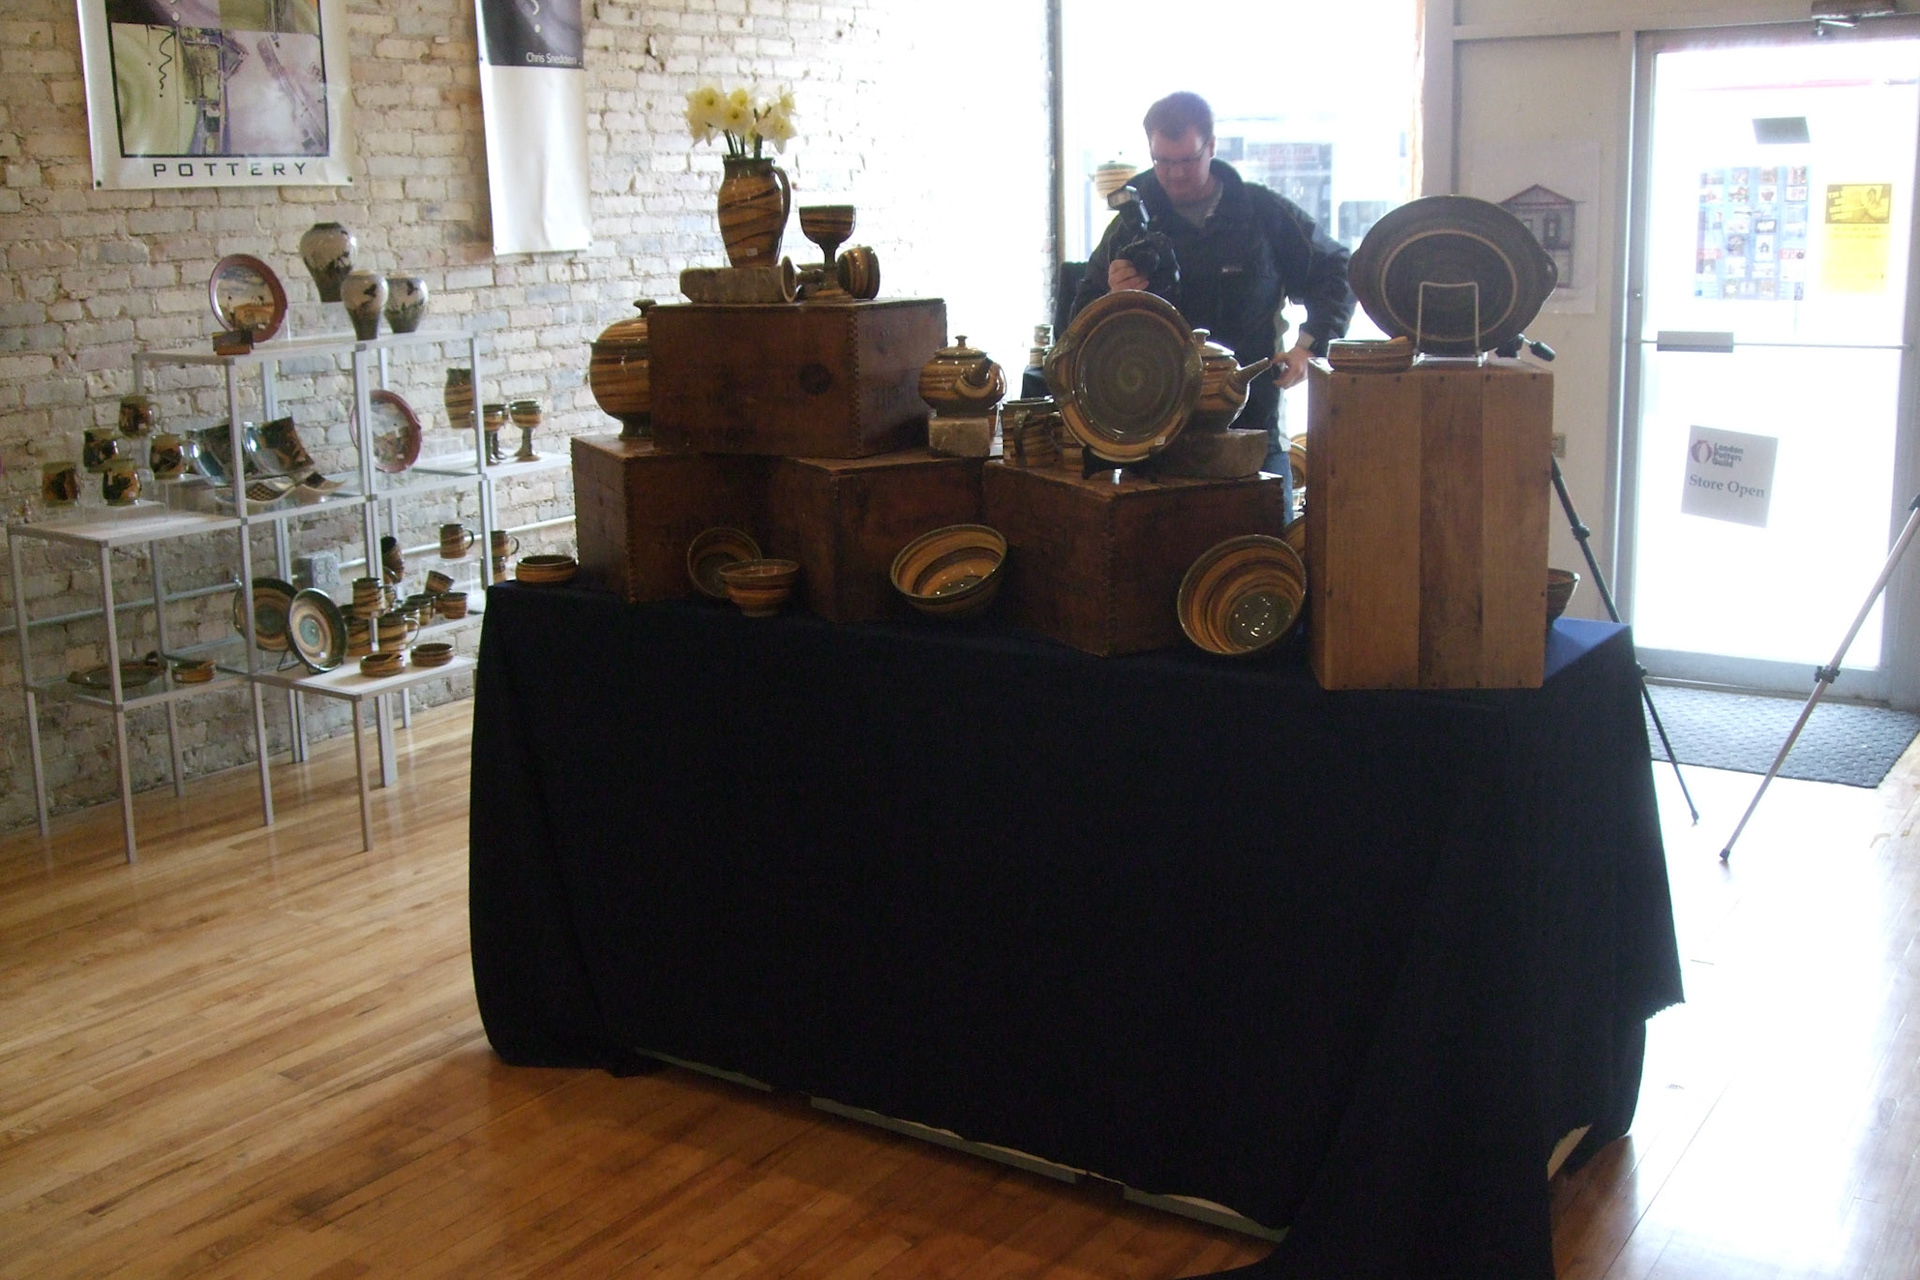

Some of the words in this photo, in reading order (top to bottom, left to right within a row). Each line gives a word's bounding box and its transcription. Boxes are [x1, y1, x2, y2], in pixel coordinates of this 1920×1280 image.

[526, 52, 545, 63] Chris
[153, 162, 306, 177] POTTERY
[1713, 442, 1744, 455] London
[1713, 450, 1742, 462] Potters
[1712, 457, 1734, 468] Guild
[1688, 474, 1724, 491] Store
[1727, 480, 1765, 498] Open
